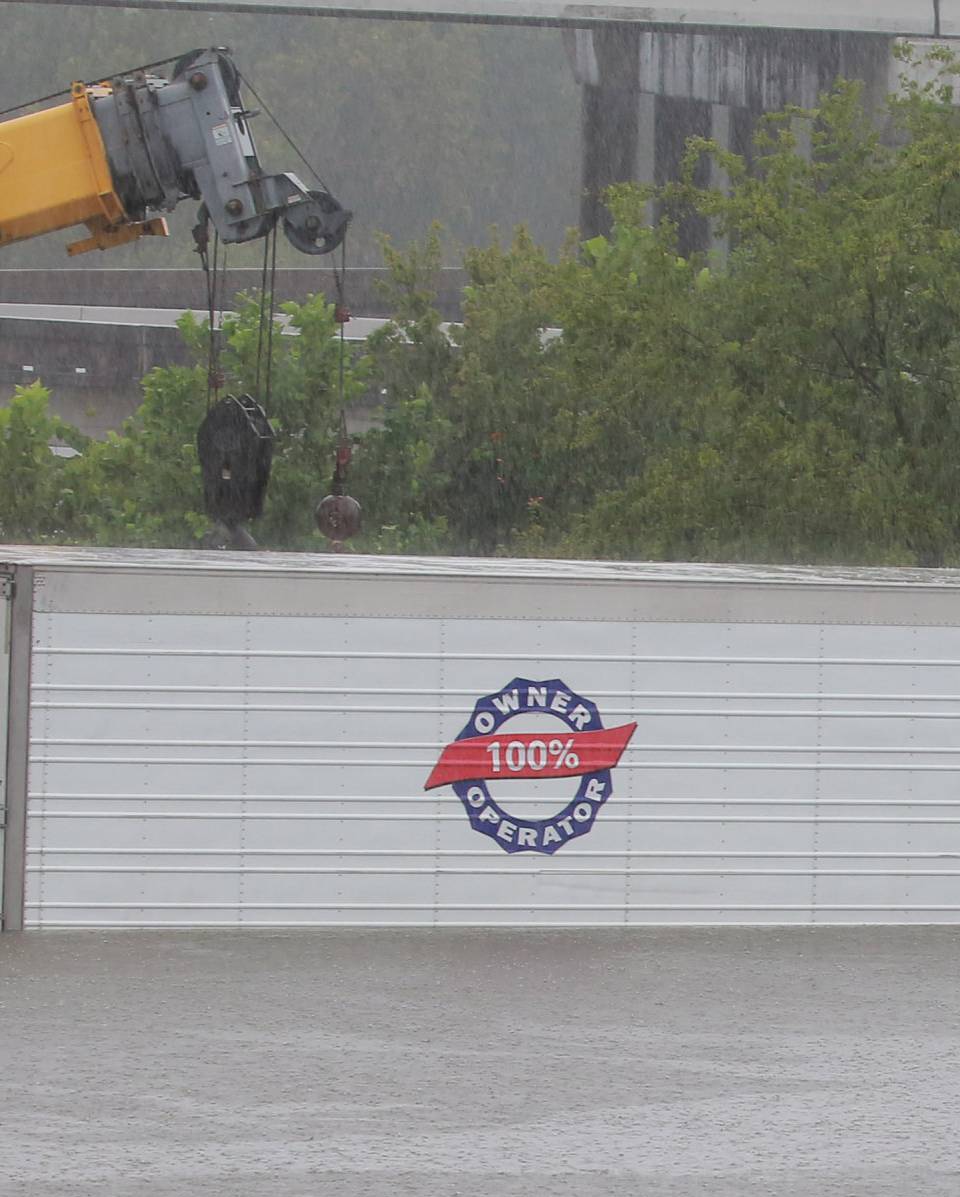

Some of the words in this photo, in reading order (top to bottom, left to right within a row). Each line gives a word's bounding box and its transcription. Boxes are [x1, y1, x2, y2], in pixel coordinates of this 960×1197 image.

[474, 686, 592, 734] OWNER
[486, 739, 580, 772] 100%
[467, 778, 606, 847] OPERATOR
